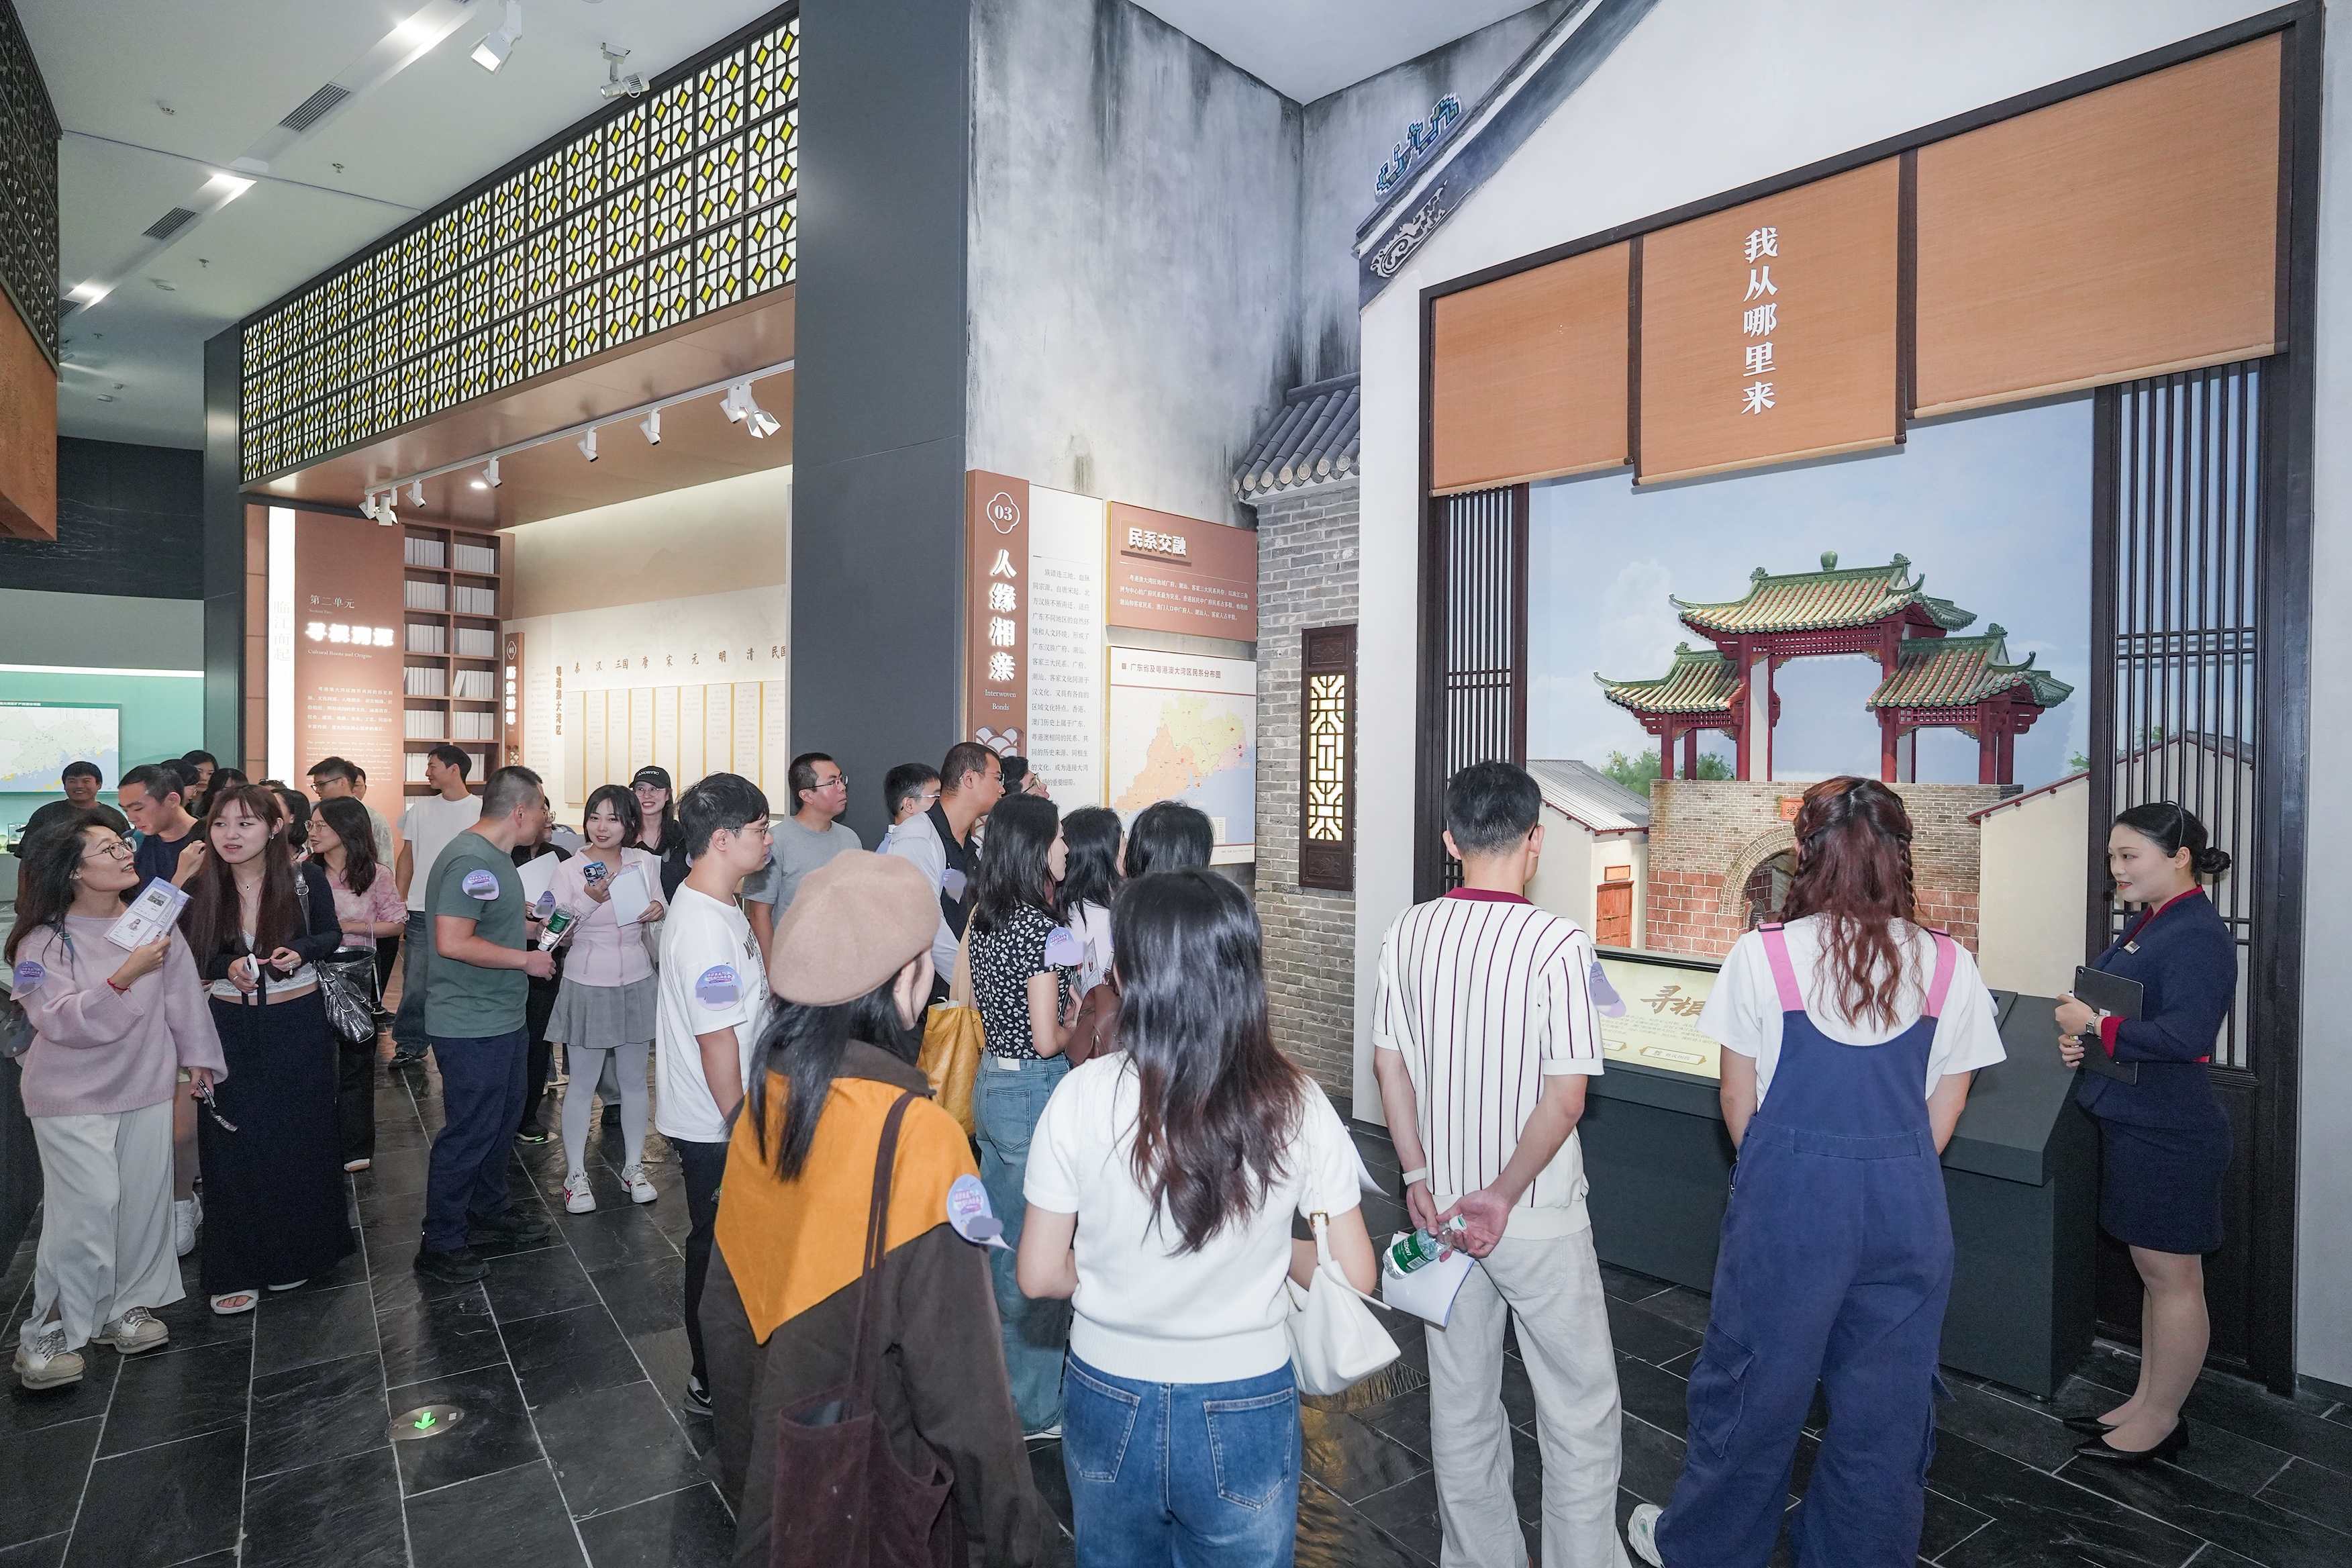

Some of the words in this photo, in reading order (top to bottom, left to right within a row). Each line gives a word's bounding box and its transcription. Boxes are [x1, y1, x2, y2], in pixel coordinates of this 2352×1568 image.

[1741, 226, 1778, 415] 我从哪里来
[995, 505, 1012, 521] 03
[1128, 527, 1187, 556] 民系交融
[310, 595, 354, 609] 第二单元
[988, 549, 1017, 682] 人缘相亲
[616, 658, 628, 670] 三国
[691, 653, 699, 665] 元
[718, 650, 726, 663] 明
[746, 647, 754, 661] 清
[1130, 663, 1221, 679] 广东省及粤港澳大湾区民系分布图
[985, 689, 1016, 698] Interwoven
